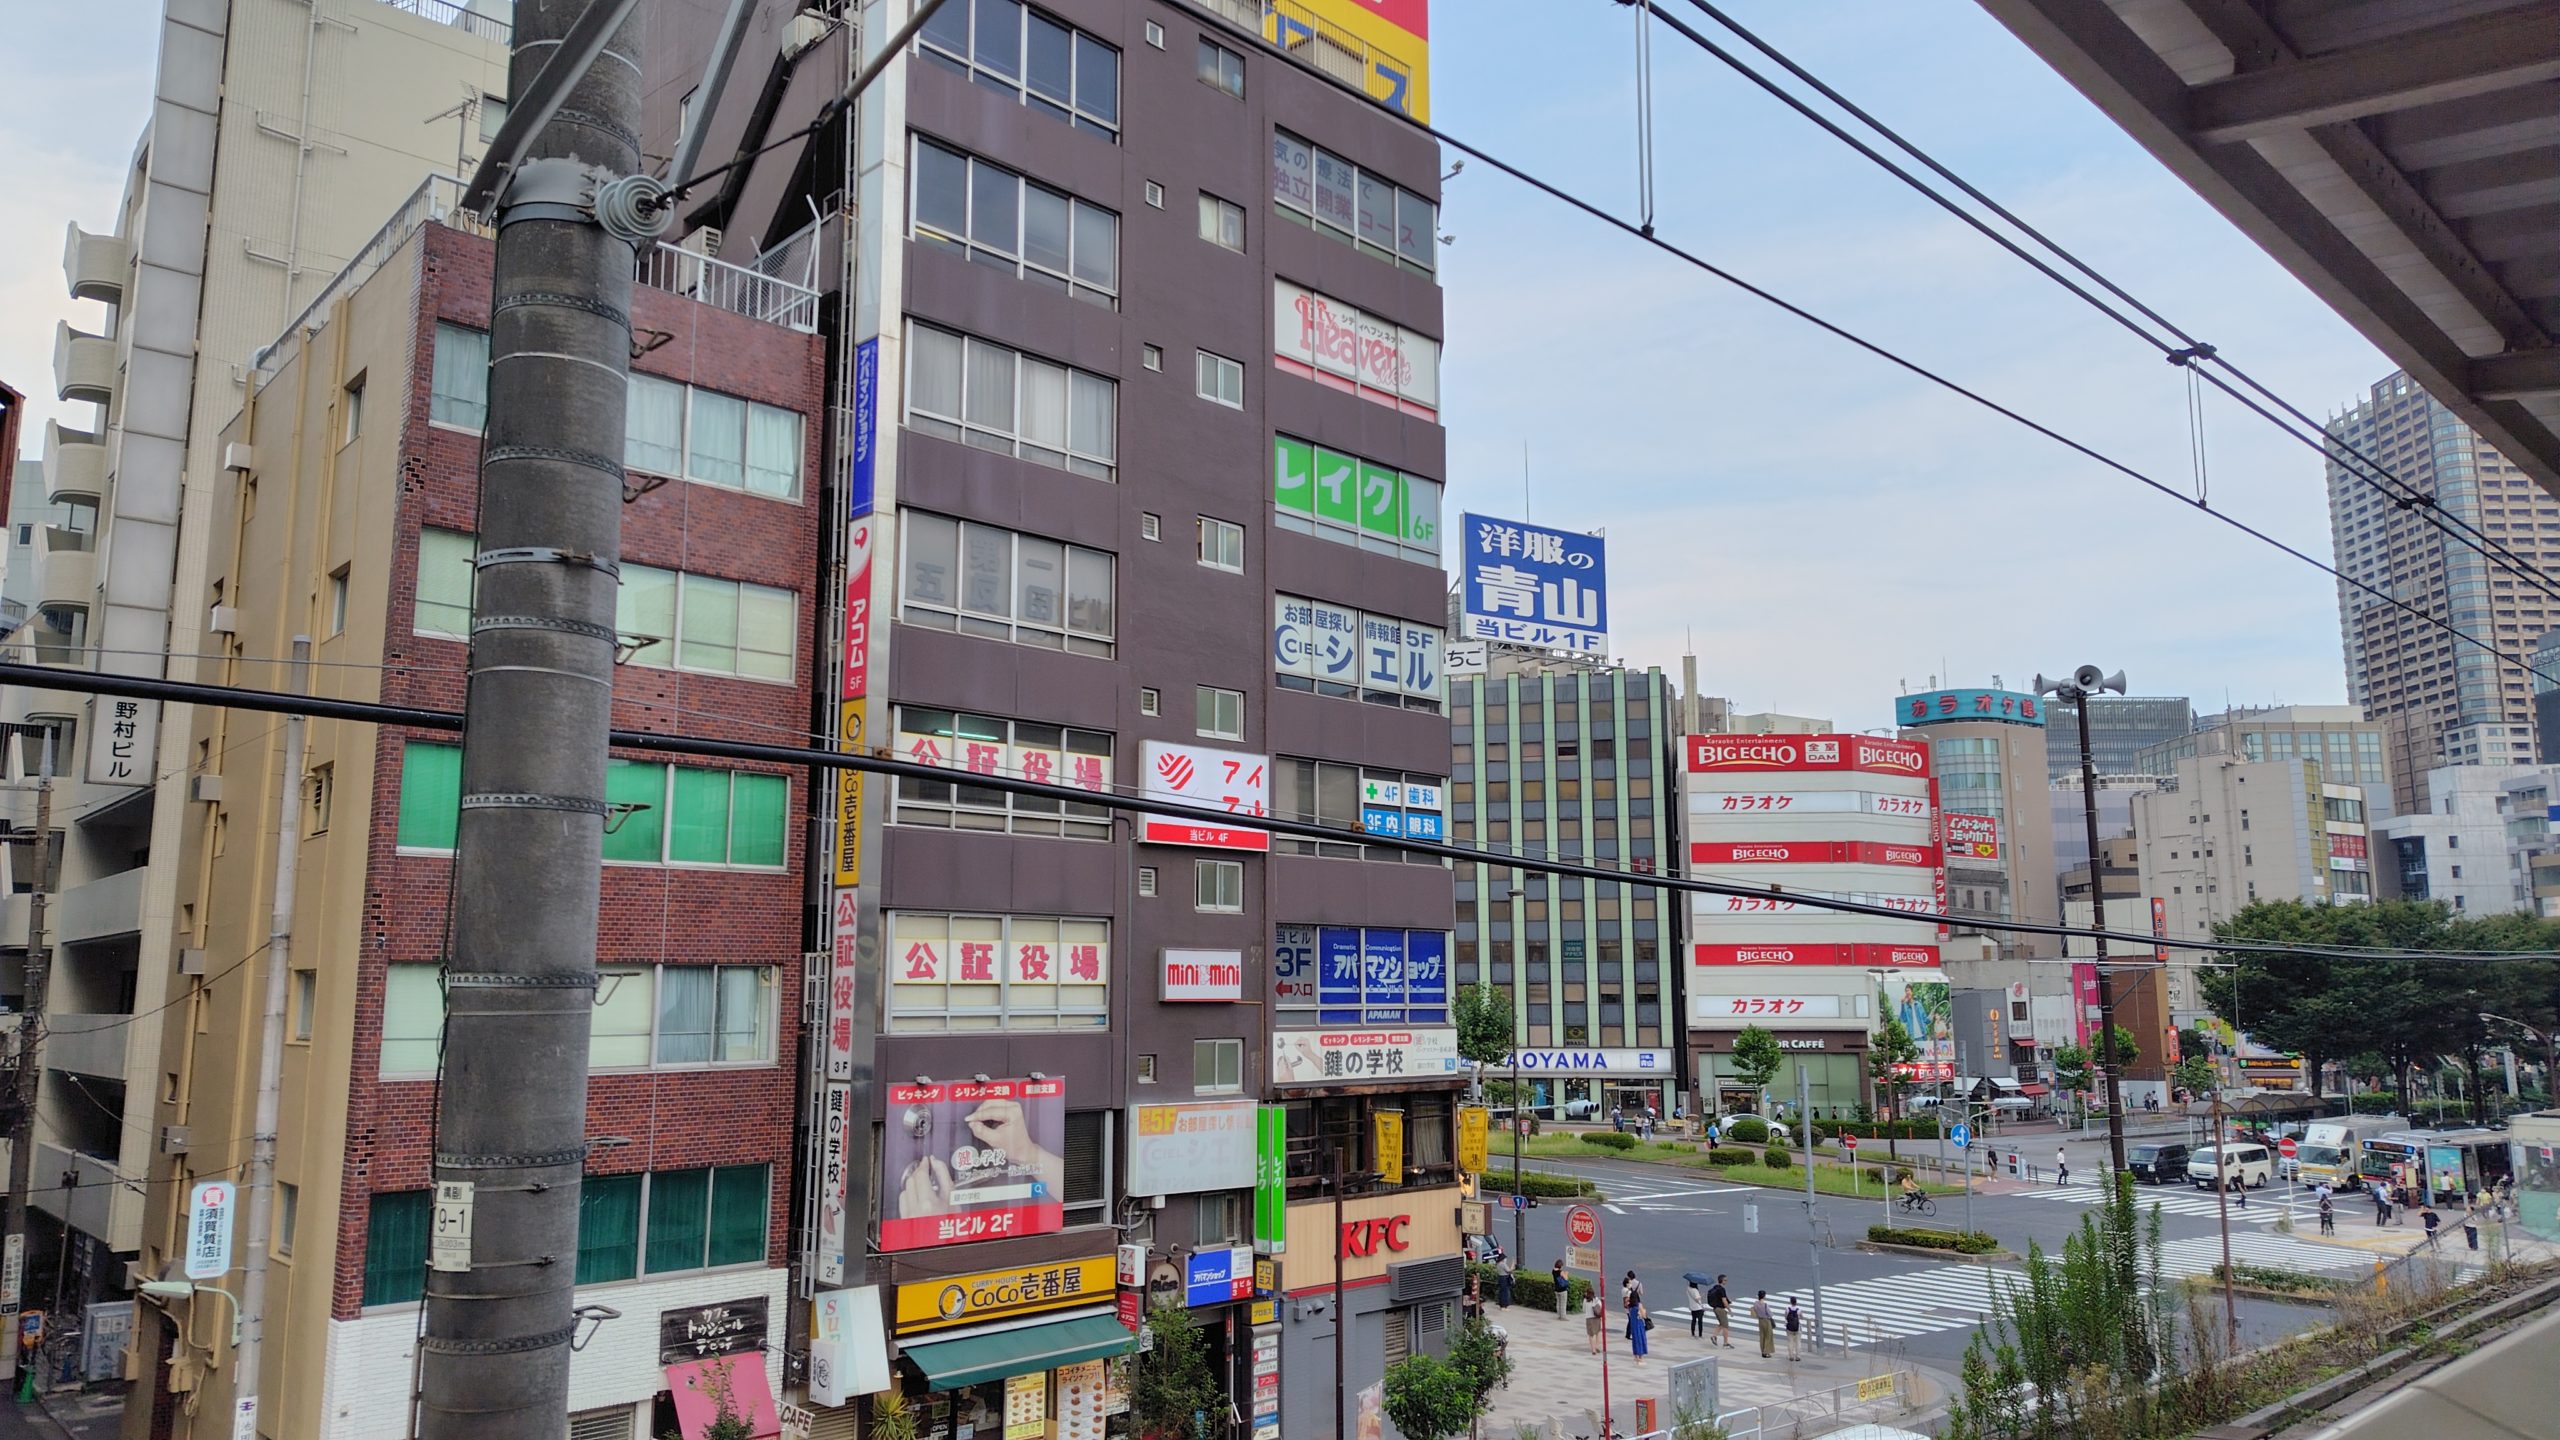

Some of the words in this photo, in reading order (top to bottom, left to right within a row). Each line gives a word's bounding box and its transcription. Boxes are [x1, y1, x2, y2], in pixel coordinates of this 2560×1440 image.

[1278, 446, 1393, 516] レイク
[1413, 514, 1434, 542] 6F
[1478, 522, 1595, 570] 洋服の
[1475, 564, 1598, 627] 青山
[850, 598, 866, 669] アコム
[1284, 603, 1354, 634] お部屋探し
[1365, 620, 1401, 645] 情報館
[1406, 630, 1434, 650] 5F
[1476, 619, 1557, 643] 当ビル
[1564, 632, 1600, 650] 1F
[1326, 634, 1434, 691] シエル
[849, 676, 863, 691] 5F
[1911, 694, 2037, 719] カラオケ館
[109, 701, 138, 778] 野村ビル
[911, 738, 1103, 793] 公証役場
[1384, 785, 1398, 801] 4F
[1408, 787, 1434, 806] 歯科
[1722, 795, 1793, 810] カラオケ
[1877, 797, 1924, 814] カラオケ
[1367, 813, 1382, 831] 3F
[1190, 830, 1214, 842] 当ビル
[1217, 832, 1229, 842] 4F
[1275, 930, 1311, 944] 当ビル
[832, 893, 857, 1053] 公証役場
[905, 942, 1100, 981] 公証役場
[1275, 947, 1312, 977] 3F
[1333, 952, 1441, 980] アパマンショップ
[1168, 964, 1199, 986] mini
[1210, 964, 1240, 986] mini
[1293, 983, 1313, 997] 入口
[1367, 1010, 1402, 1019] APAMAN
[1731, 999, 1804, 1014] カラオケ
[1790, 1039, 1825, 1049] CAFFÉ
[1324, 1048, 1403, 1077] 鍵の学校
[1505, 1052, 1608, 1069] AOYAMA
[897, 1087, 940, 1100] ピッキング
[828, 1088, 843, 1185] 鍵の学校
[1257, 1154, 1267, 1190] レイク
[1274, 1157, 1282, 1187] レイク
[202, 1208, 219, 1258] 須賀質店
[438, 1208, 465, 1234] 9-1
[938, 1217, 986, 1240] 当ビル
[990, 1213, 1014, 1233] 2F
[1572, 1220, 1593, 1235] 消火栓
[1341, 1214, 1411, 1260] KFC
[826, 1266, 837, 1279] 2F
[972, 1279, 993, 1288] CURRY
[995, 1275, 1018, 1285] HOUSE
[1258, 1264, 1272, 1275] プロ
[1258, 1275, 1272, 1286] ミス
[971, 1266, 1080, 1307] CoCo壱番屋
[702, 1307, 730, 1323] カフェ
[1253, 1307, 1272, 1317] プロミス
[1058, 1364, 1102, 1376] ココイチメニュー
[780, 1405, 812, 1434] CAFE
[932, 1424, 948, 1432] OPEN
